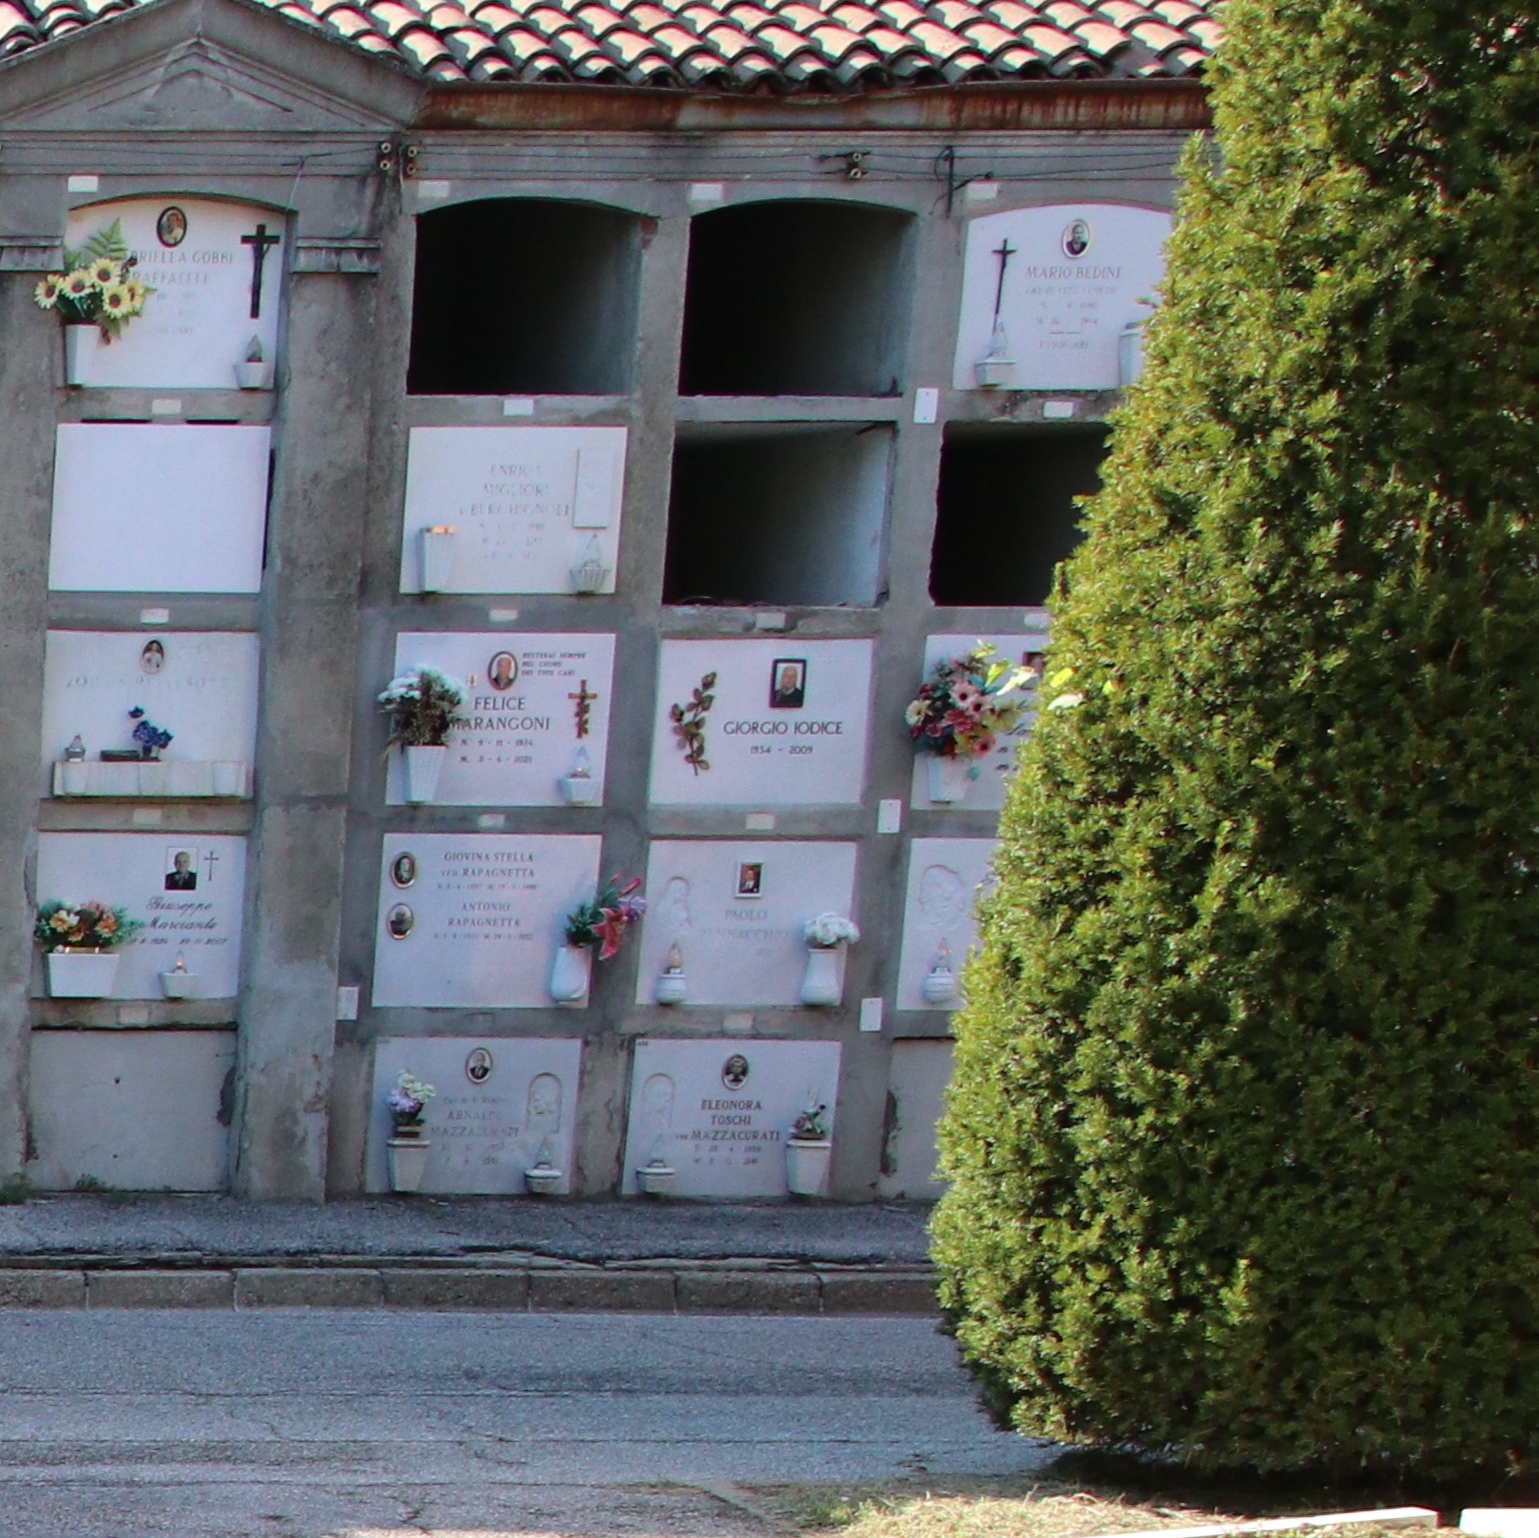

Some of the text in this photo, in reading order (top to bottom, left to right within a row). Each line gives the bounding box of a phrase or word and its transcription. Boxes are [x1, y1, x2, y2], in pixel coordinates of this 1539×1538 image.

[1026, 266, 1121, 279] MARIO BEDINI
[474, 696, 526, 711] FELICE
[722, 721, 844, 735] GIORGIO IODICE
[443, 851, 534, 862] GIOVINA STELLA
[462, 868, 535, 877] RAPAGNETTA
[145, 896, 213, 917] Giuseppe
[461, 902, 511, 911] ANTONIO
[447, 918, 520, 927] RAPAGNETTA
[700, 1099, 762, 1111] ELEONORA
[711, 1115, 752, 1125] TOSCHI
[691, 1130, 780, 1141] MAZZACURATI
